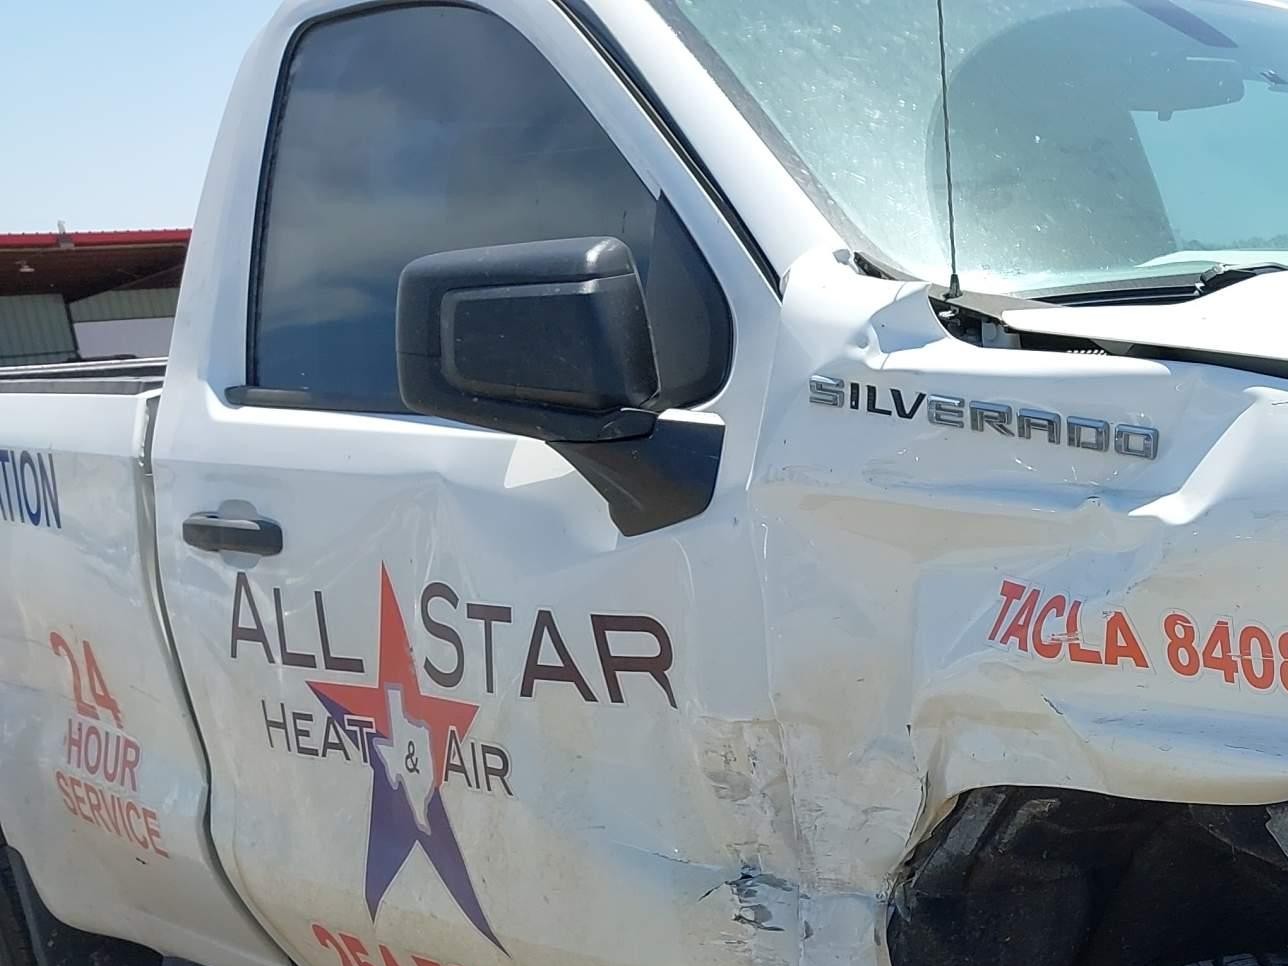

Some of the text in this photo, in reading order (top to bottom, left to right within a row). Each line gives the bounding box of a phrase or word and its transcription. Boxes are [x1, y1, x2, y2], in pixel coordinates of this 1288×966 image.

[808, 374, 1160, 461] SILVERADO
[0, 449, 61, 529] TION
[229, 571, 678, 709] ALL STAR
[988, 578, 1150, 669] TACLA
[50, 630, 124, 729] 24
[66, 719, 141, 792] HOUR
[260, 698, 514, 796] HEAT & AIR
[56, 771, 169, 858] SERVICE
